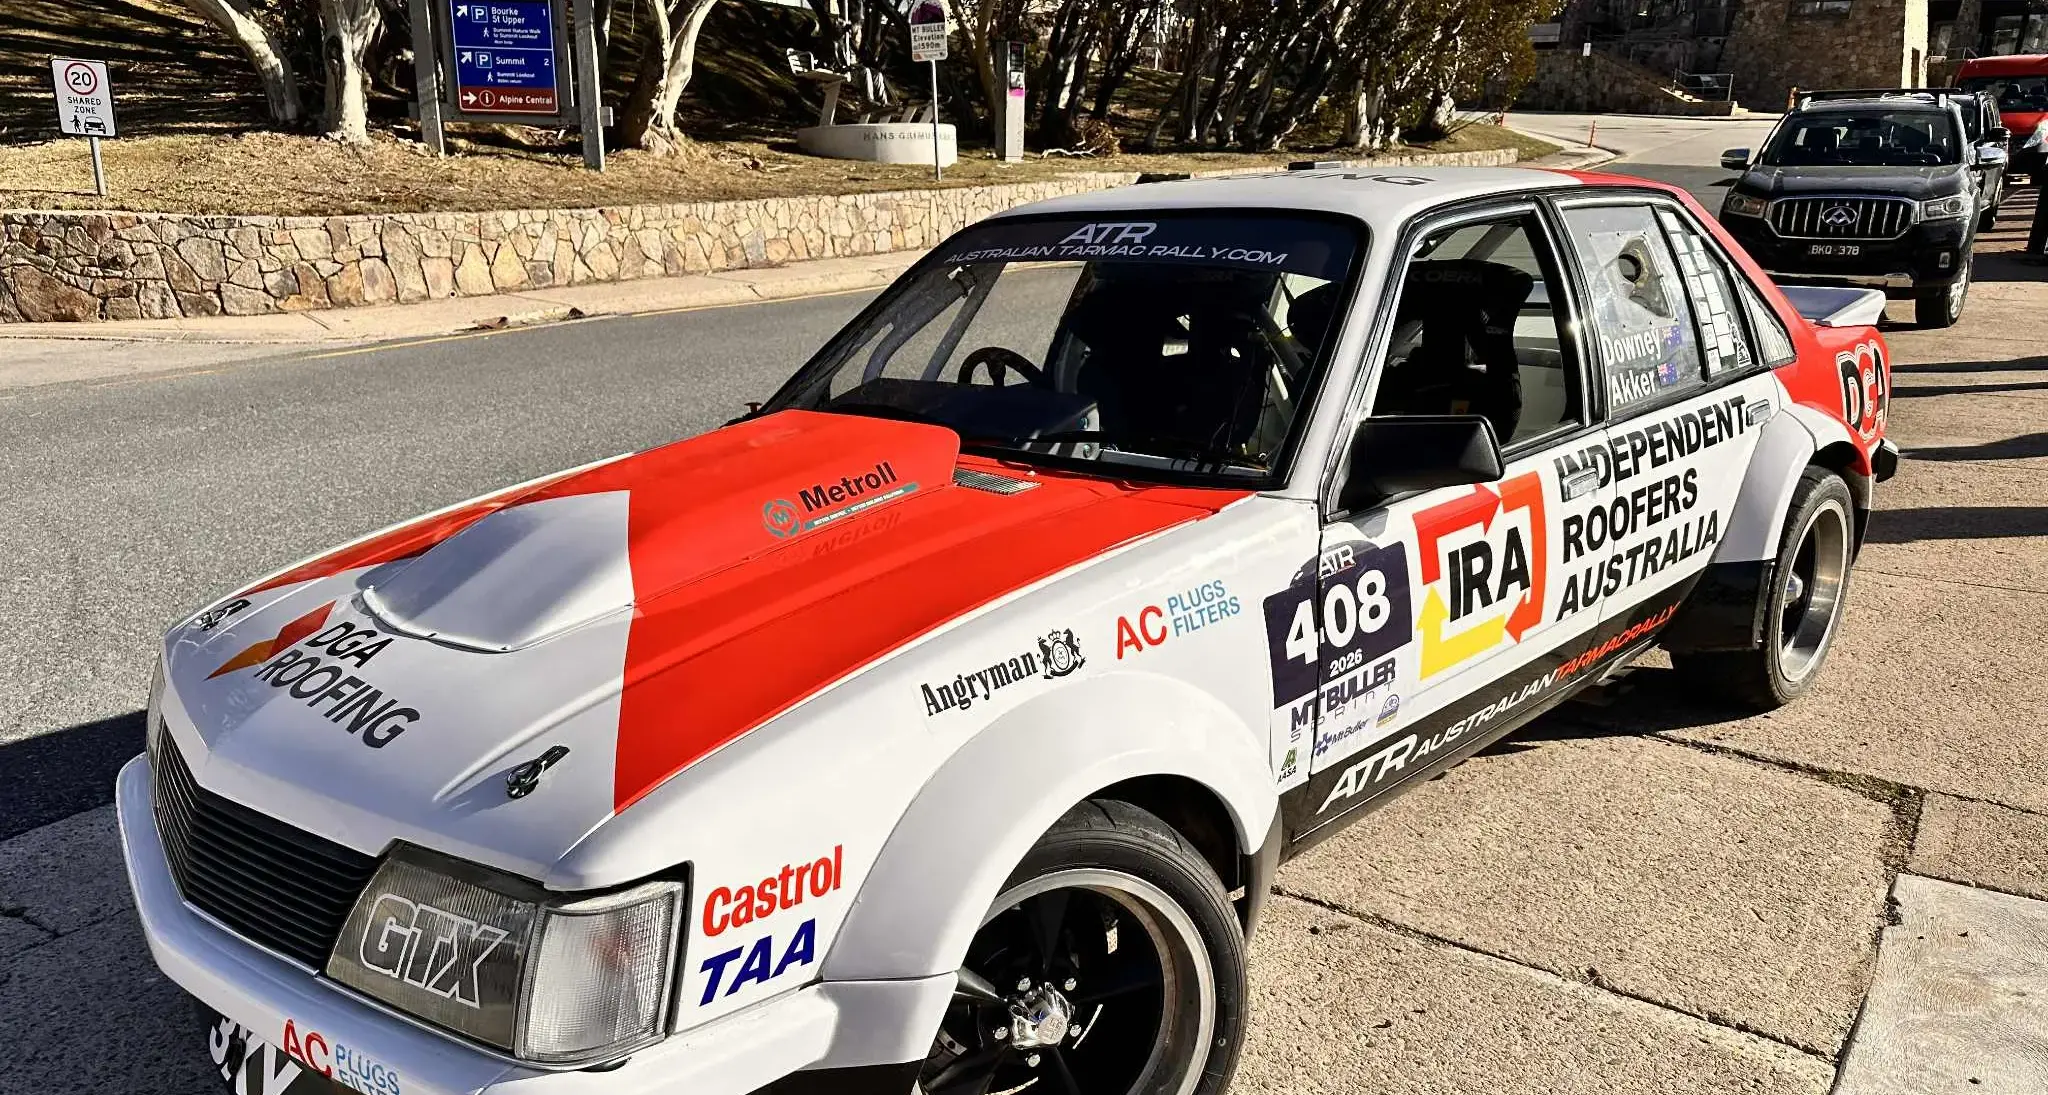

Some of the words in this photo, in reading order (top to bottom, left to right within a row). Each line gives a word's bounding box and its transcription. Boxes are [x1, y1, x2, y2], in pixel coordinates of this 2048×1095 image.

[491, 6, 519, 16] Bourke
[492, 15, 501, 23] St
[502, 15, 526, 25] Upper
[913, 33, 945, 42] Elevation
[71, 71, 92, 87] 20
[495, 56, 525, 65] Summit
[543, 58, 550, 66] 2
[67, 96, 102, 106] SHARED
[74, 105, 97, 115] ZONE
[499, 95, 523, 105] Alpine
[525, 95, 553, 105] Central
[863, 131, 895, 141] HANS
[1060, 222, 1158, 245] ATR
[945, 245, 1056, 265] AUSTRALIAN
[1060, 244, 1146, 257] TARMAC
[1600, 326, 1662, 367] Downey
[1611, 369, 1656, 407] Akker
[799, 461, 898, 513] Metroll
[1563, 467, 1698, 564] ROOFERS
[1318, 545, 1356, 580] ATR
[1447, 526, 1531, 623] IRA
[1555, 509, 1719, 623] AUSTRALIA
[1117, 605, 1168, 660] AC
[1167, 579, 1226, 616] PLUGS
[1172, 596, 1241, 637] FILTERS
[1285, 569, 1391, 665] 408
[304, 621, 395, 669] DGA
[1329, 648, 1364, 677] 2026
[253, 649, 421, 749] ROOFING
[920, 650, 1039, 717] Angryman
[1316, 733, 1418, 815] ATR
[702, 844, 843, 938] Castrol
[359, 893, 510, 1009] GTX
[699, 917, 816, 1008] TAA
[283, 1019, 332, 1078] AC
[335, 1043, 400, 1095] PLUGS
